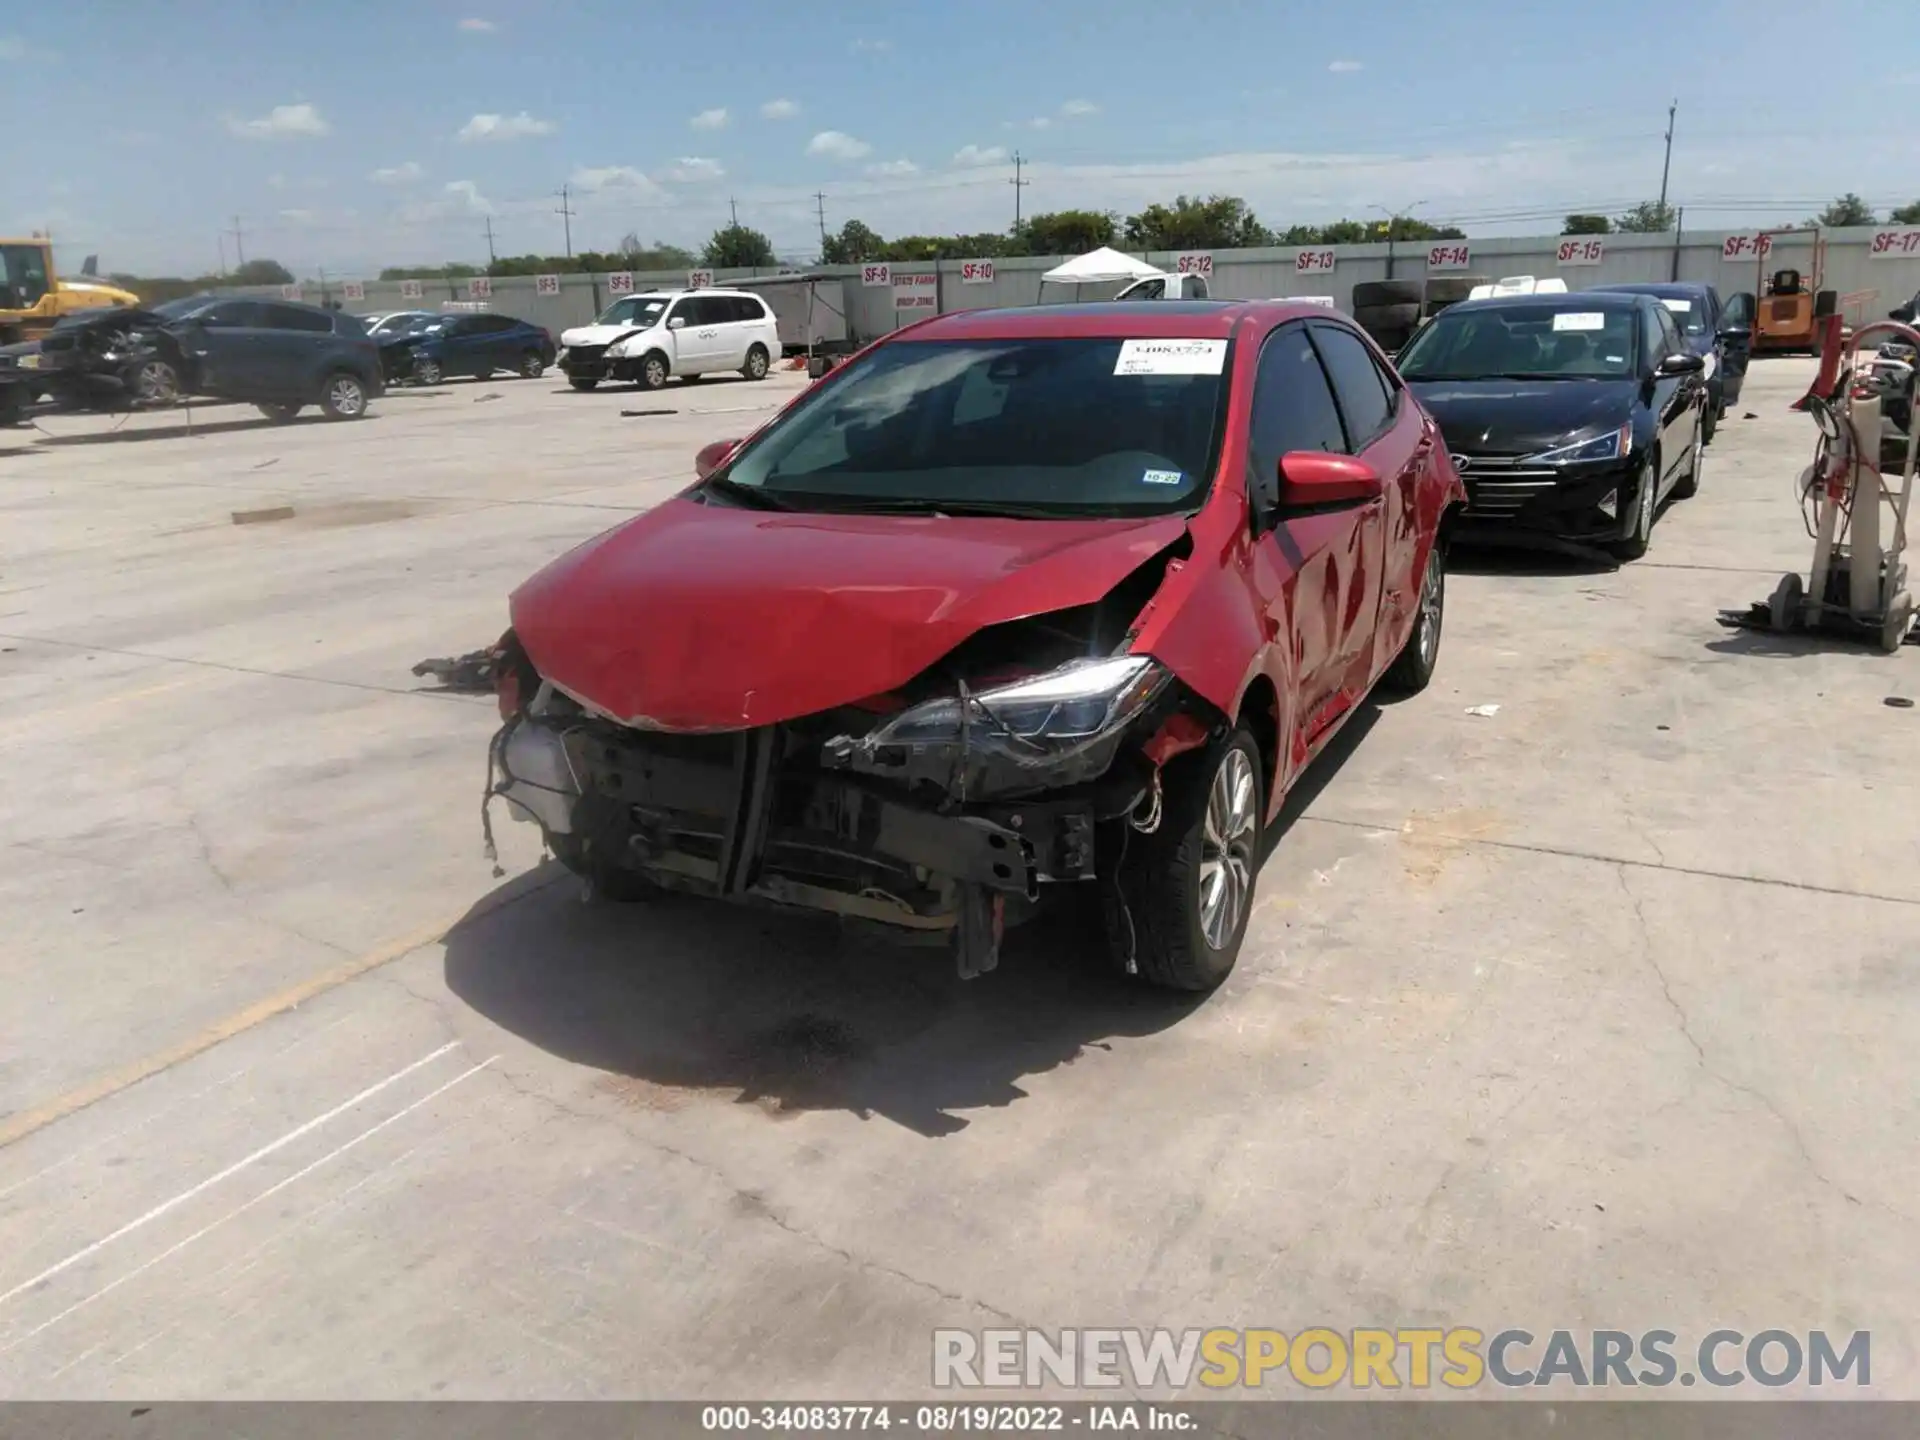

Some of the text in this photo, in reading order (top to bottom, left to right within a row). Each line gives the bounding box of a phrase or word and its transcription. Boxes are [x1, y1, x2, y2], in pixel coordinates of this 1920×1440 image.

[1558, 241, 1601, 260] SF-15
[1873, 231, 1920, 252] SF-17
[1178, 255, 1212, 272] SF-12
[1297, 251, 1333, 269] SF-13
[1429, 247, 1468, 265] SF-14
[865, 267, 888, 282] SF-9
[963, 263, 992, 279] SF-10
